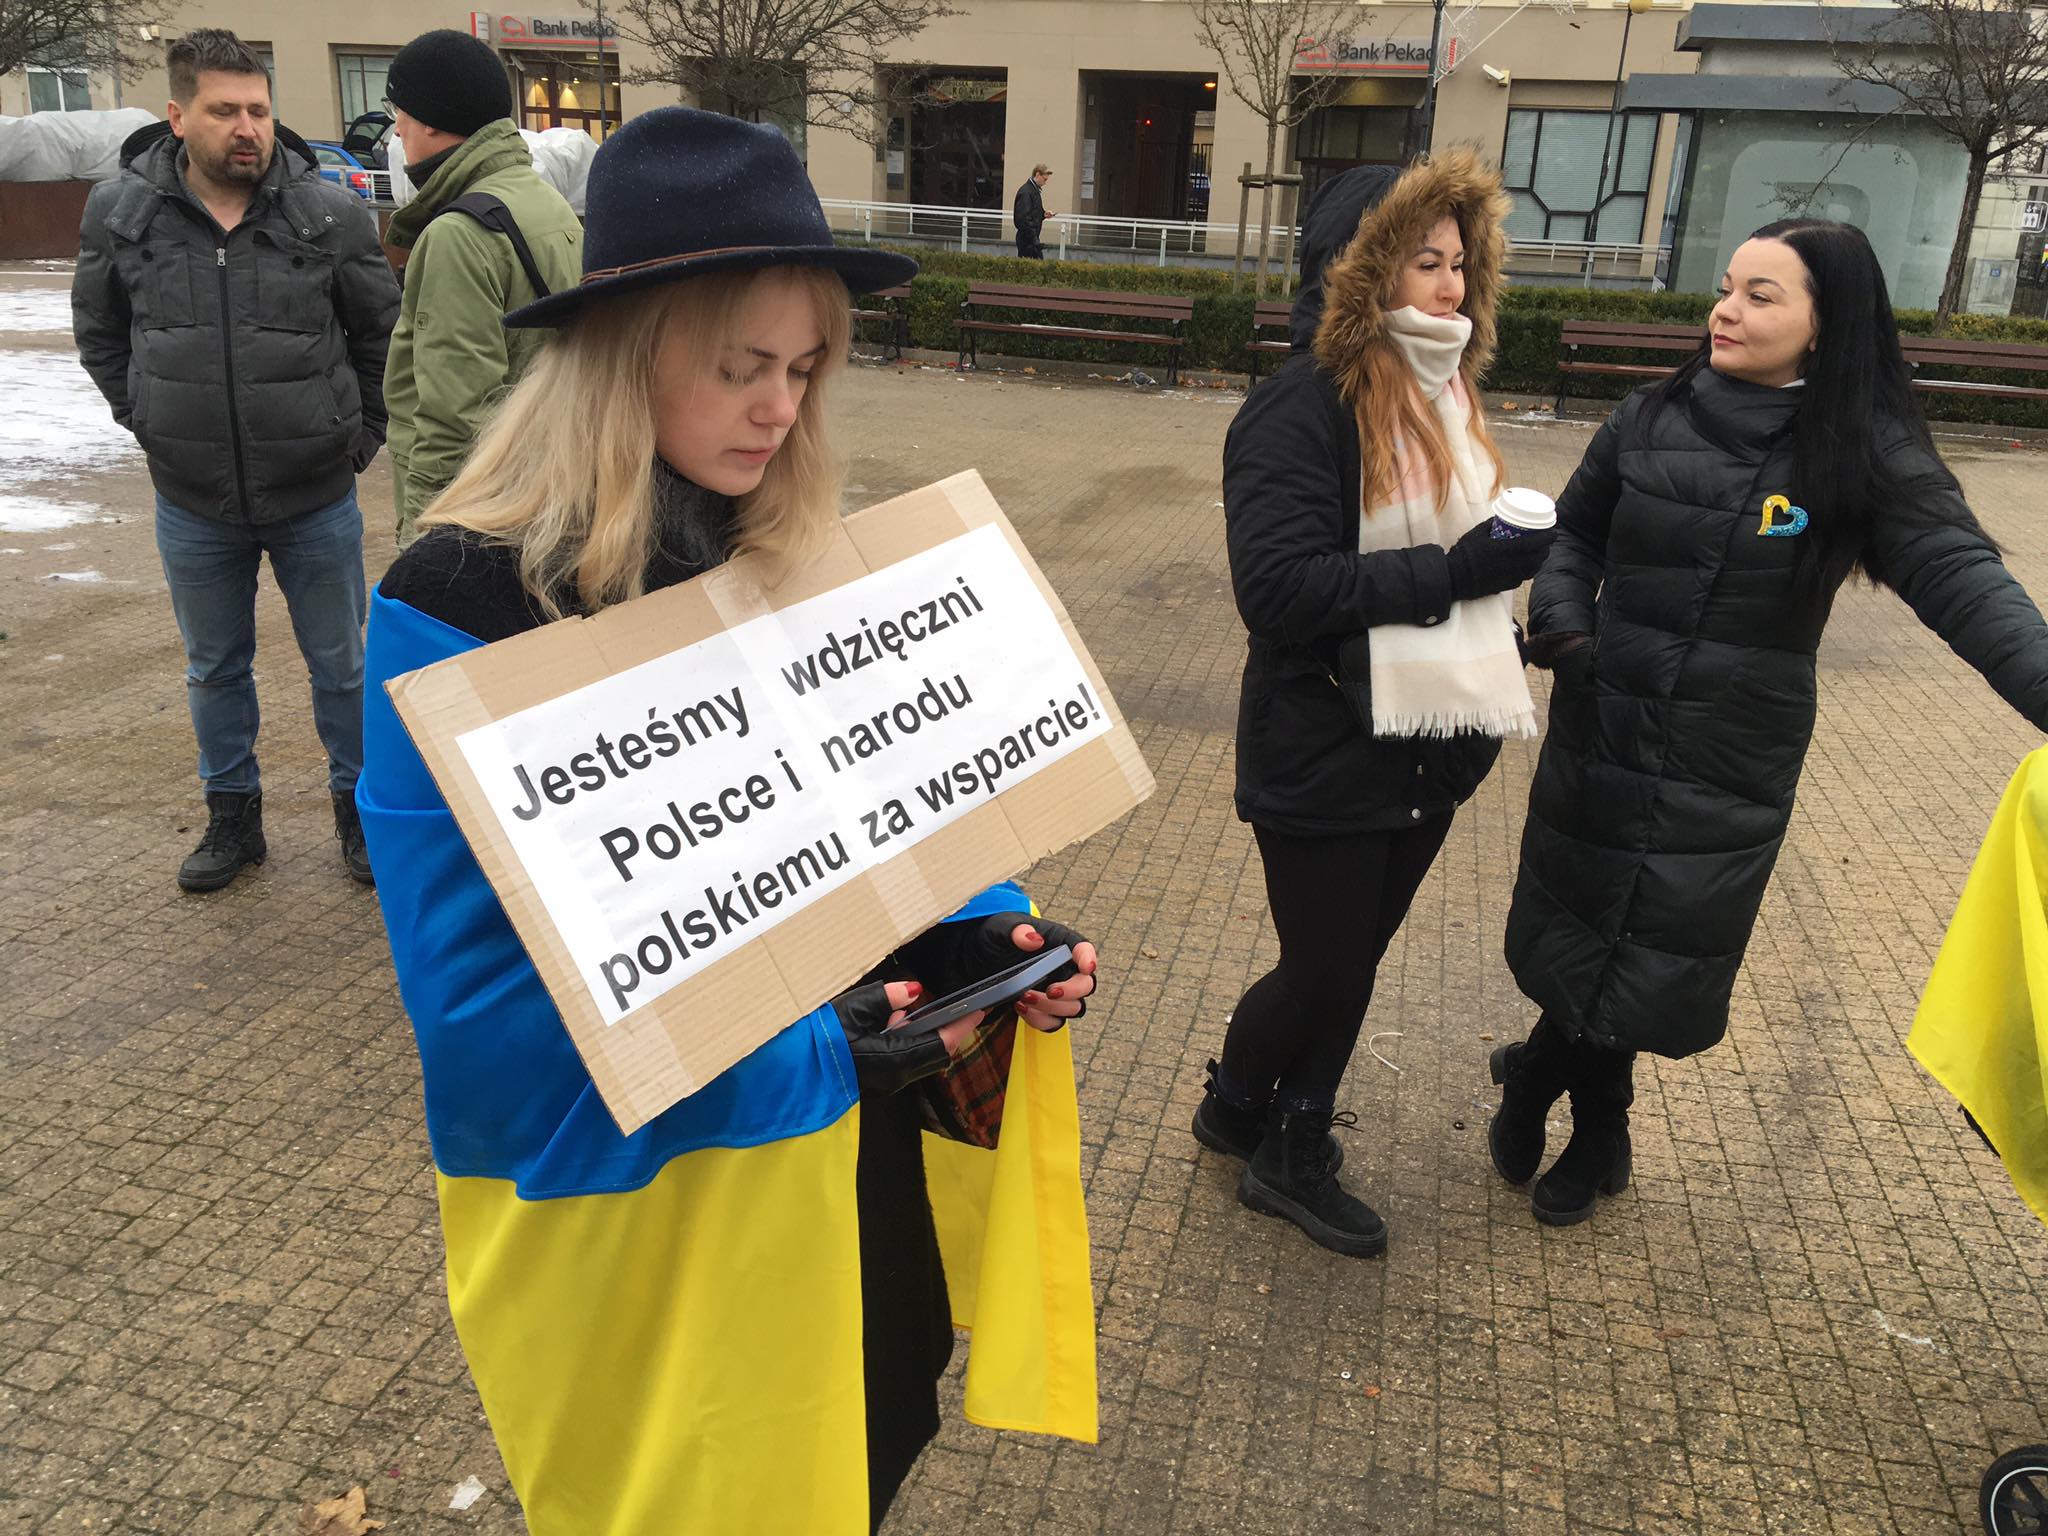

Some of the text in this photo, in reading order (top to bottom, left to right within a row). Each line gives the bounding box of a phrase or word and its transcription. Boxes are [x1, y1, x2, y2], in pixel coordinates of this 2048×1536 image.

[533, 19, 567, 36] Bank
[1338, 42, 1379, 61] Bank
[511, 575, 984, 821] Jesteśmy wdzięczni
[599, 671, 973, 883] Polsce i narodu
[600, 682, 1101, 1011] polskiemu za wsparcie!
